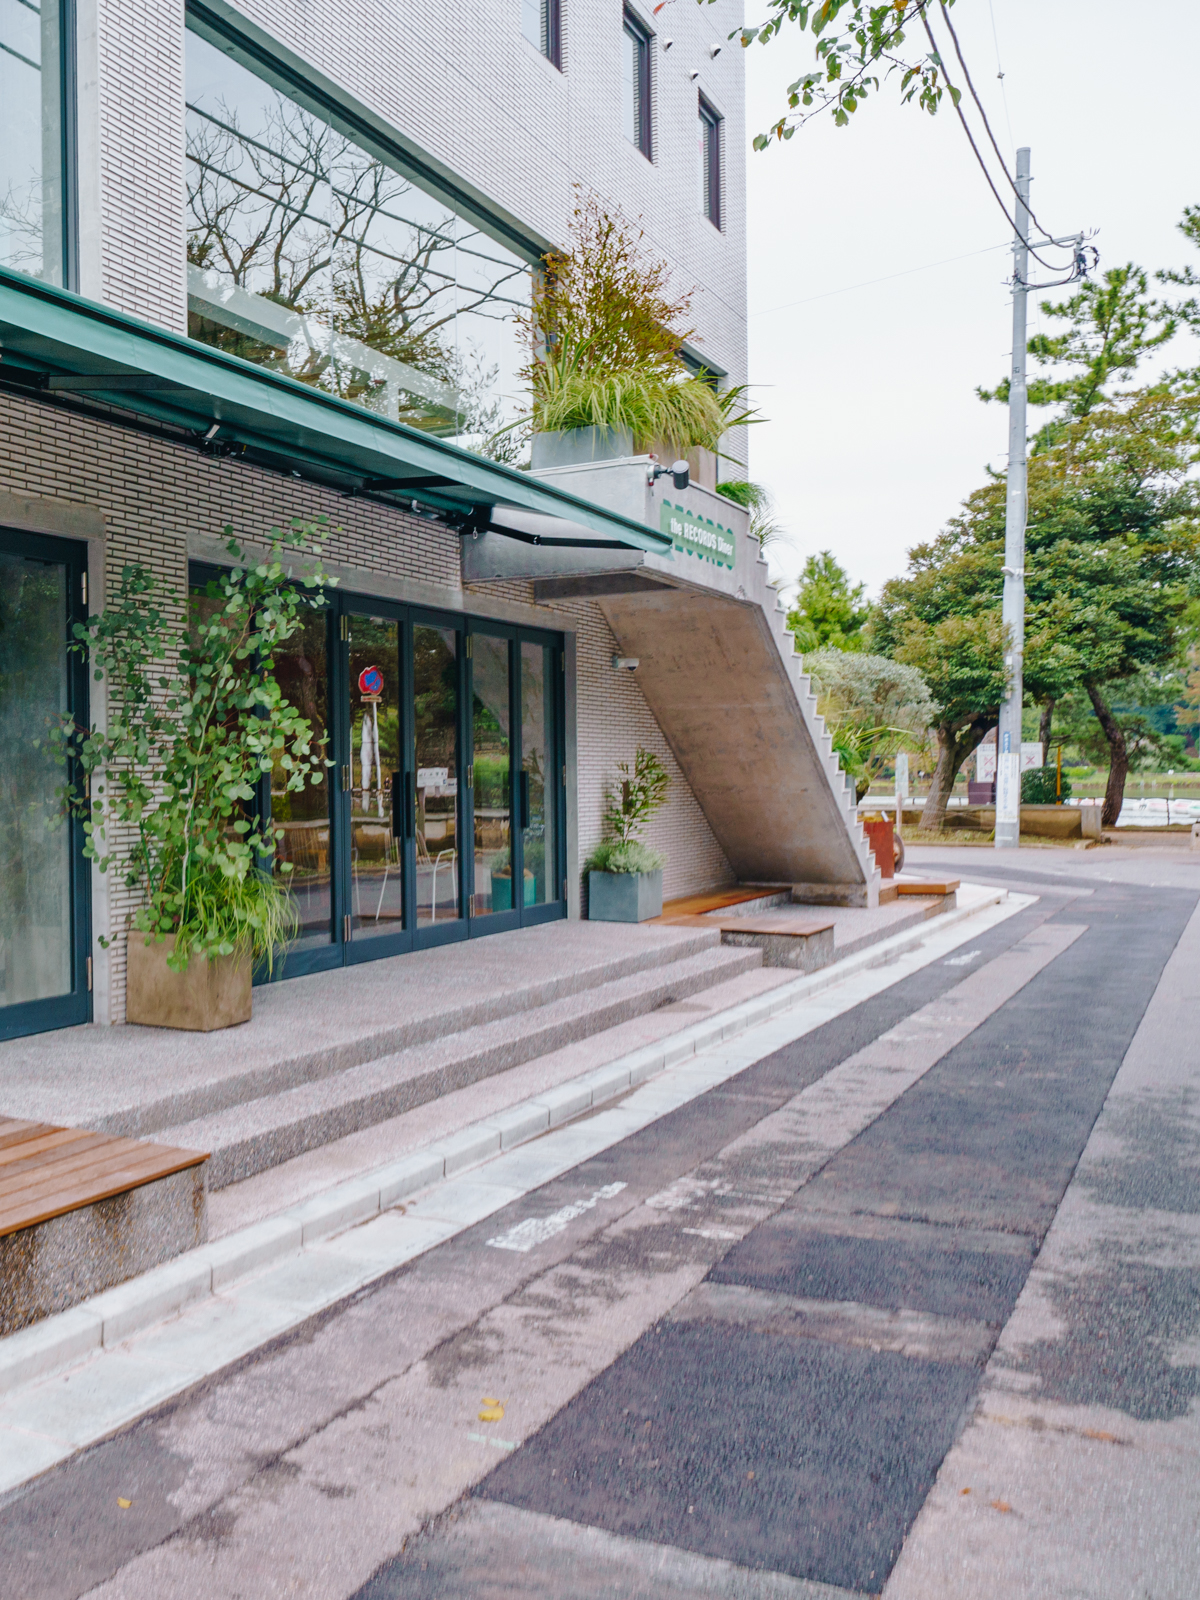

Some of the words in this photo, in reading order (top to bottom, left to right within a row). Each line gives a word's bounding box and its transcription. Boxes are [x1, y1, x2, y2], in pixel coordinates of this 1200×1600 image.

[670, 517, 682, 536] the
[683, 522, 717, 550] RECORDS
[717, 536, 734, 556] Diner
